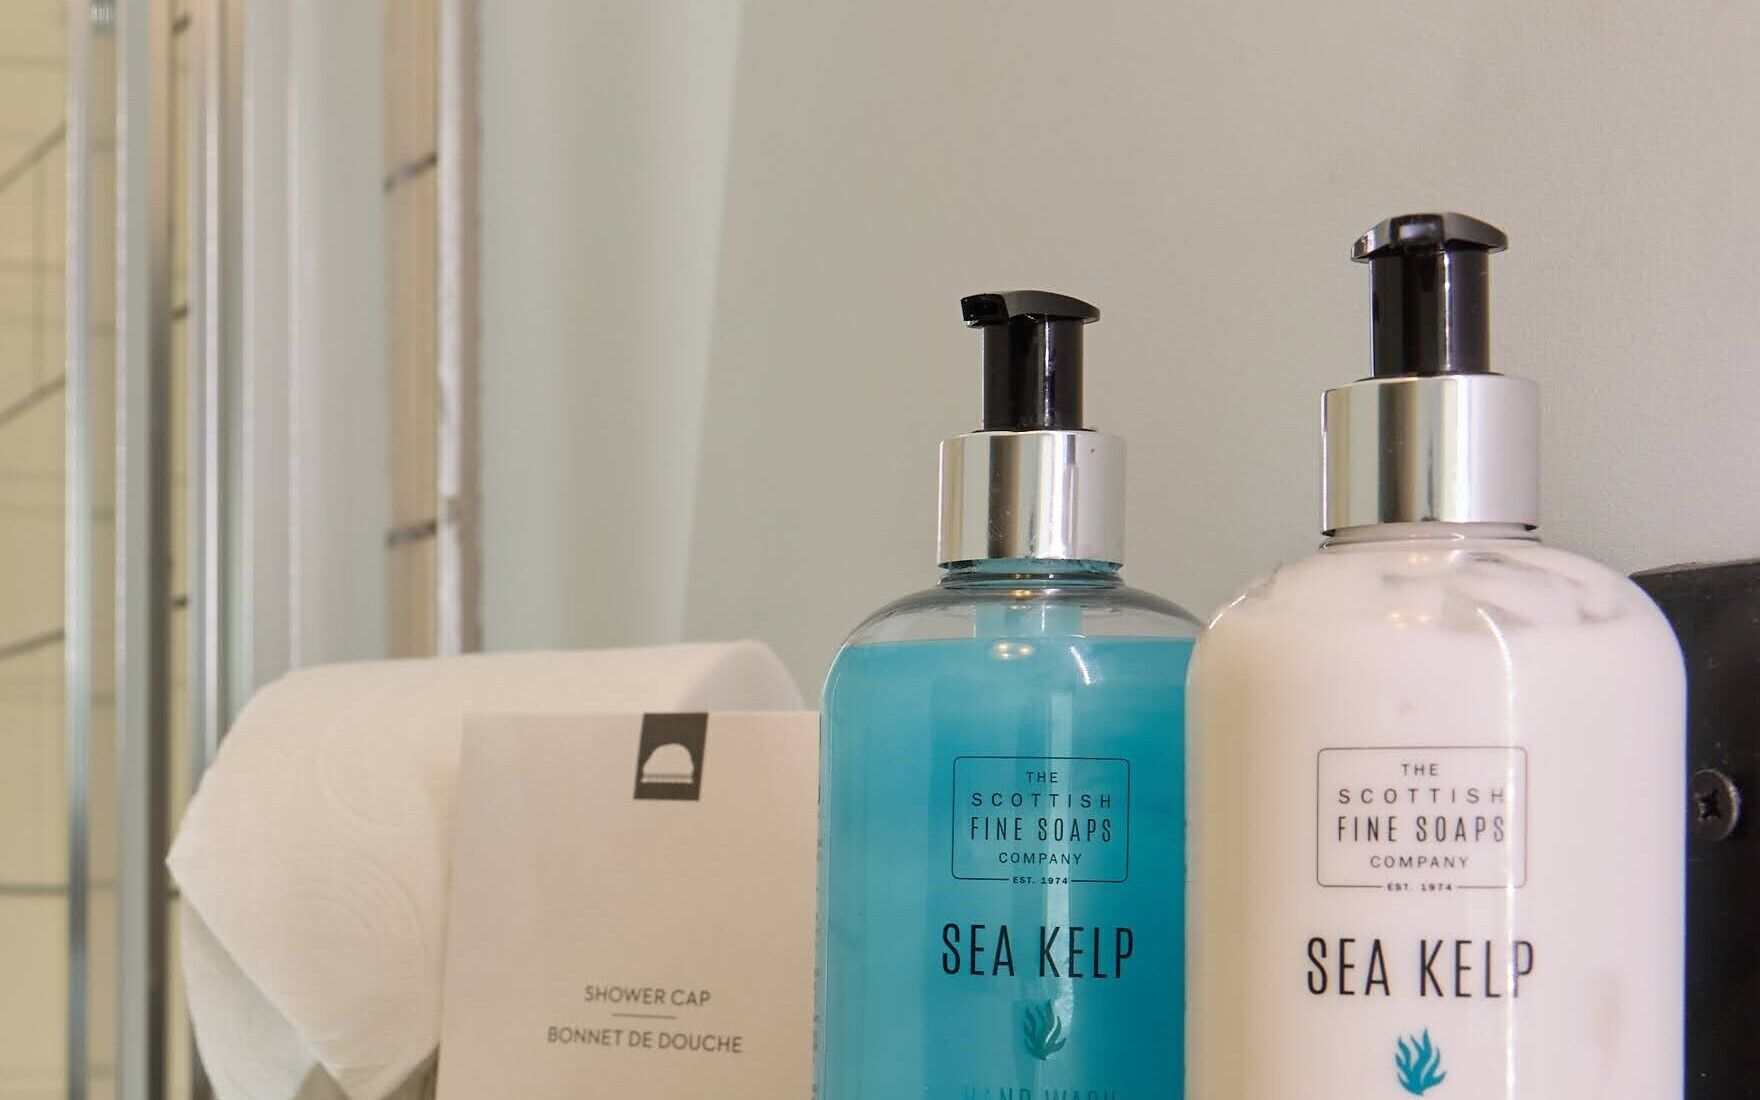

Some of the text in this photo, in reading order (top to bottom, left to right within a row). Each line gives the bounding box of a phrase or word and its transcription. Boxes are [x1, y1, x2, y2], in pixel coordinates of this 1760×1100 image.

[1026, 771, 1059, 783] THE
[1402, 763, 1439, 776] THE
[971, 792, 1112, 808] SCOTTISH
[1338, 788, 1505, 804] SCOTTISH
[970, 817, 1112, 842] FINE SOAPS
[1337, 816, 1505, 842] FINE SOAPS
[998, 852, 1082, 865] COMPANY
[1370, 856, 1469, 868] COMPANY
[1012, 876, 1069, 885] EST. 1974
[942, 923, 1134, 979] SEA KELP
[1307, 937, 1534, 998] SEA KELP
[584, 985, 711, 1006] SHOWER CAP
[547, 1026, 743, 1053] BONNET DE DOUCHE
